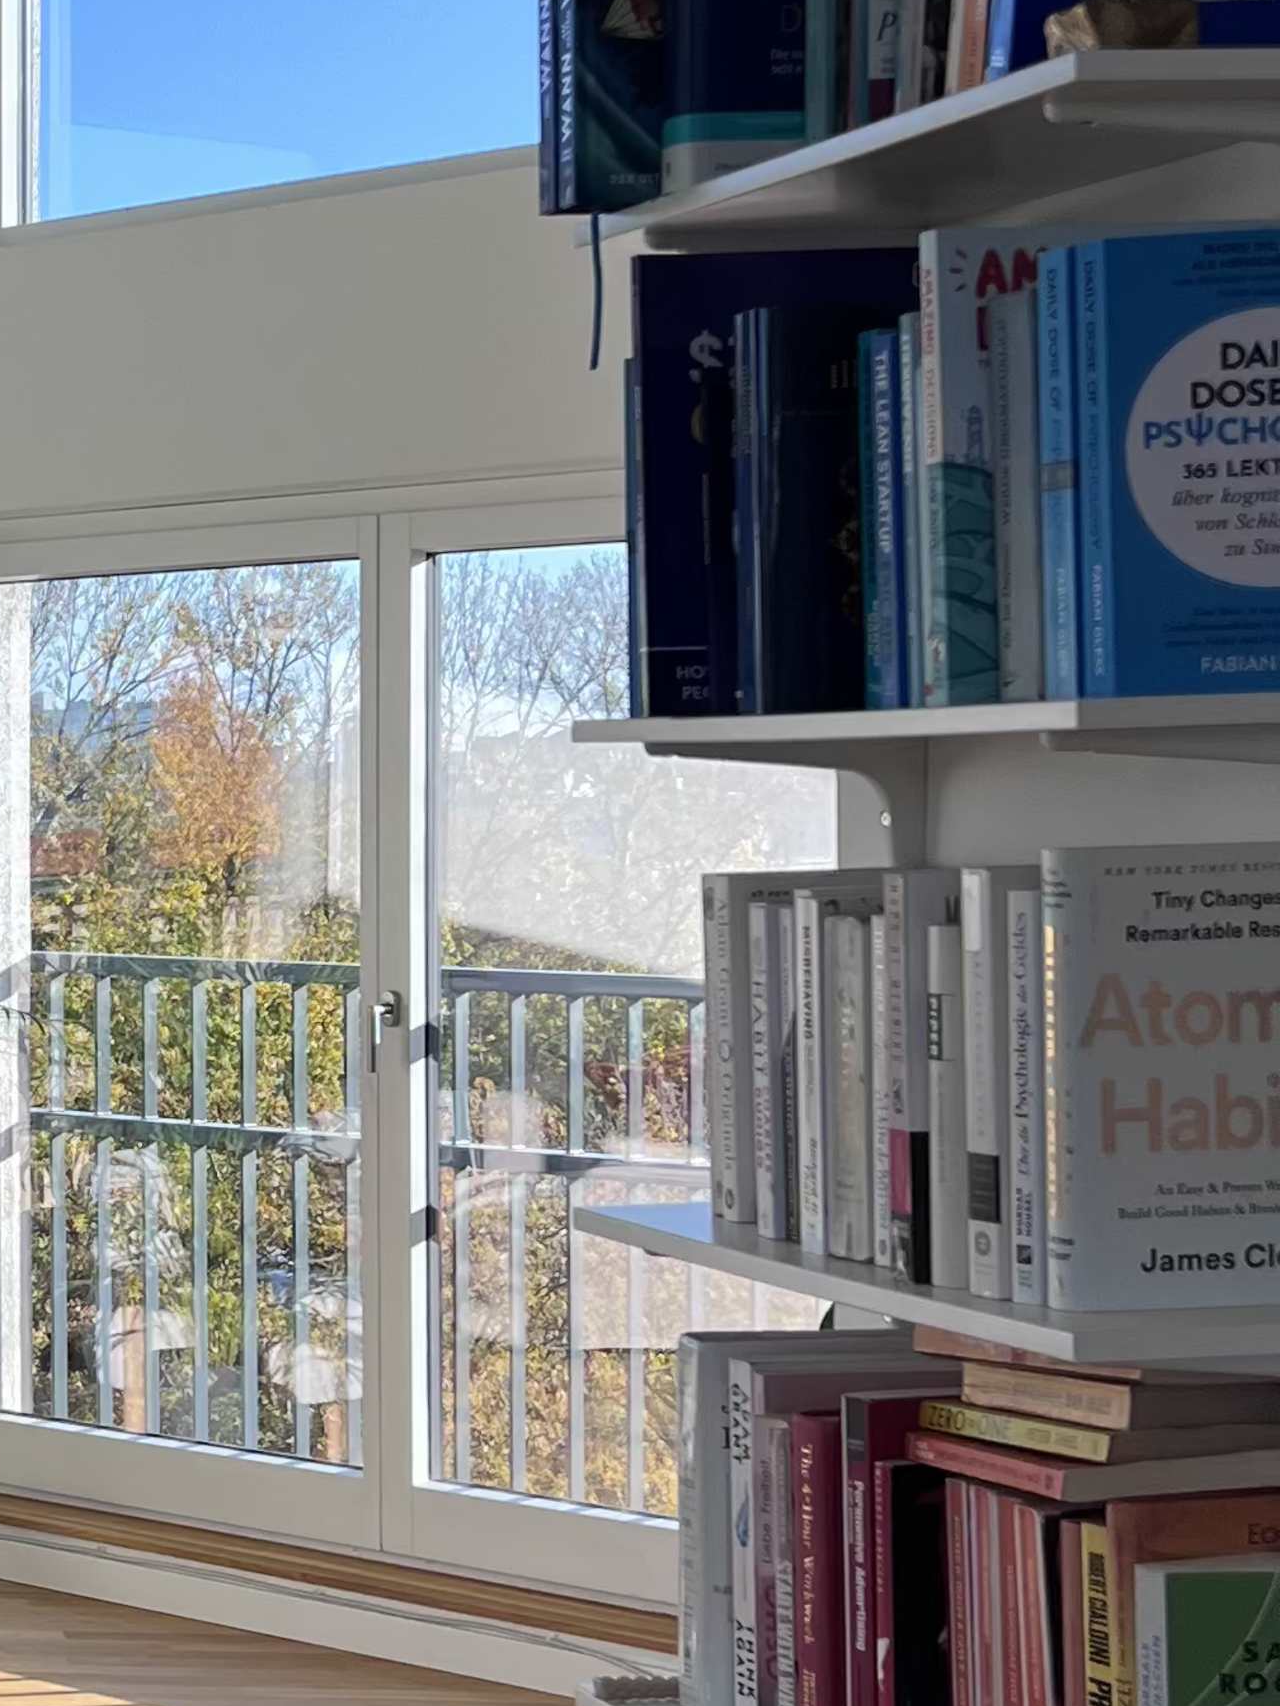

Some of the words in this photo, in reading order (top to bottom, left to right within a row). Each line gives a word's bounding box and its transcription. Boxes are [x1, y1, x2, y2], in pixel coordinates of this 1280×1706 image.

[561, 53, 572, 142] WANN
[874, 348, 890, 394] THE
[1220, 339, 1279, 371] DAI
[1189, 376, 1280, 410] DOSE
[875, 397, 891, 455] LEAN
[1181, 463, 1219, 480] 365
[877, 459, 894, 556] STARTUP
[1125, 920, 1244, 944] Remarkable
[1151, 890, 1196, 913] Tiny
[718, 967, 730, 1029] Grant
[802, 925, 813, 1041] MISBEHAVING
[752, 980, 764, 1075] HABIT
[929, 996, 938, 1056] PIPER
[1014, 1007, 1033, 1120] Psychologie
[721, 1072, 734, 1170] Originals
[1141, 1246, 1237, 1274] James
[1243, 1242, 1280, 1269] Cl
[731, 1382, 744, 1466] GRANT
[928, 1404, 966, 1432] ZERO
[977, 1413, 1013, 1438] ONE
[800, 1442, 814, 1476] The
[800, 1482, 815, 1549] 4-Hour
[854, 1480, 865, 1563] Persuasive
[776, 1559, 792, 1625] START
[800, 1555, 815, 1645] Workweek
[1088, 1551, 1105, 1594] ROBERT
[855, 1566, 867, 1651] Advertising
[1088, 1596, 1109, 1666] CIALDINI
[745, 1620, 757, 1700] THINK
[777, 1626, 792, 1673] WITH
